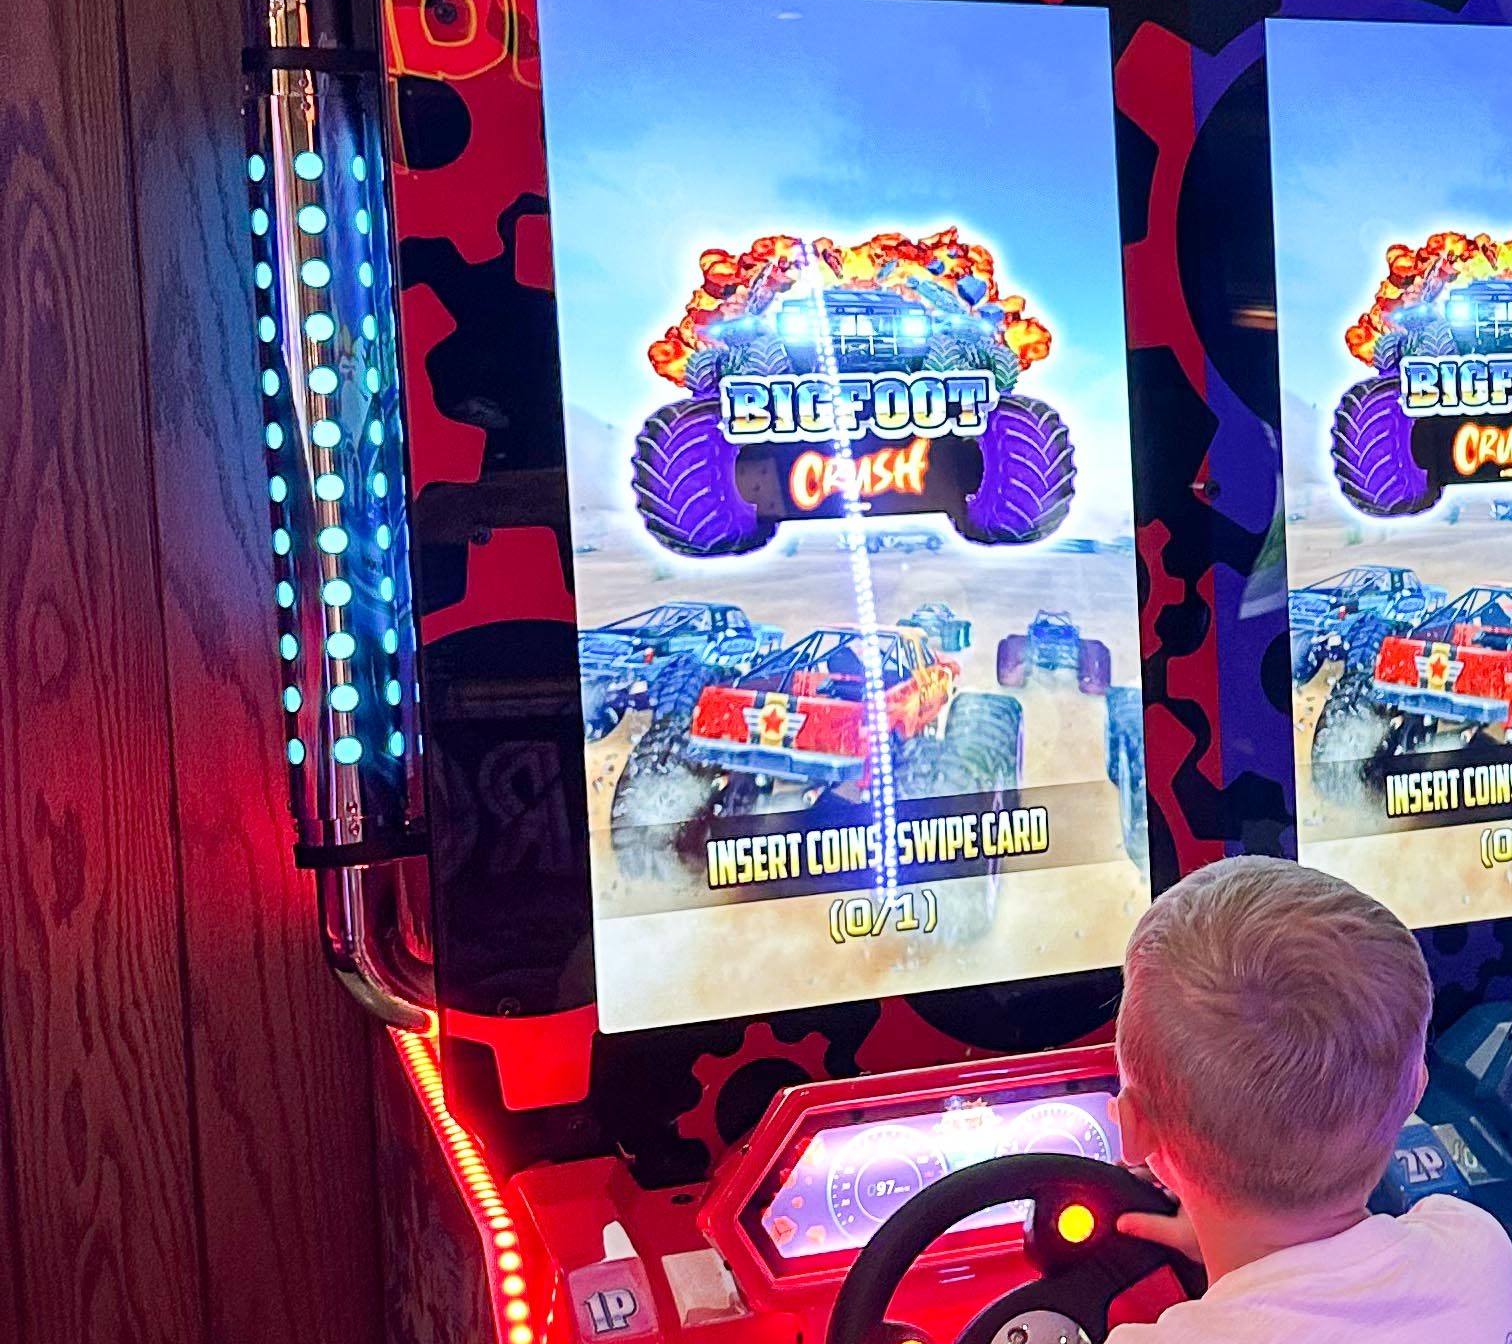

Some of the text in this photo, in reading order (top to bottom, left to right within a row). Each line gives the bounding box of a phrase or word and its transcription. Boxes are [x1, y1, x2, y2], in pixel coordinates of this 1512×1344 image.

[725, 377, 991, 435] BIGFOOT
[1386, 774, 1461, 819] INSERT
[706, 835, 801, 889] INSERT
[981, 806, 1049, 862] CARD
[829, 887, 938, 944] (0/1)
[1394, 1145, 1446, 1184] 2P
[583, 1288, 639, 1334] 1P
